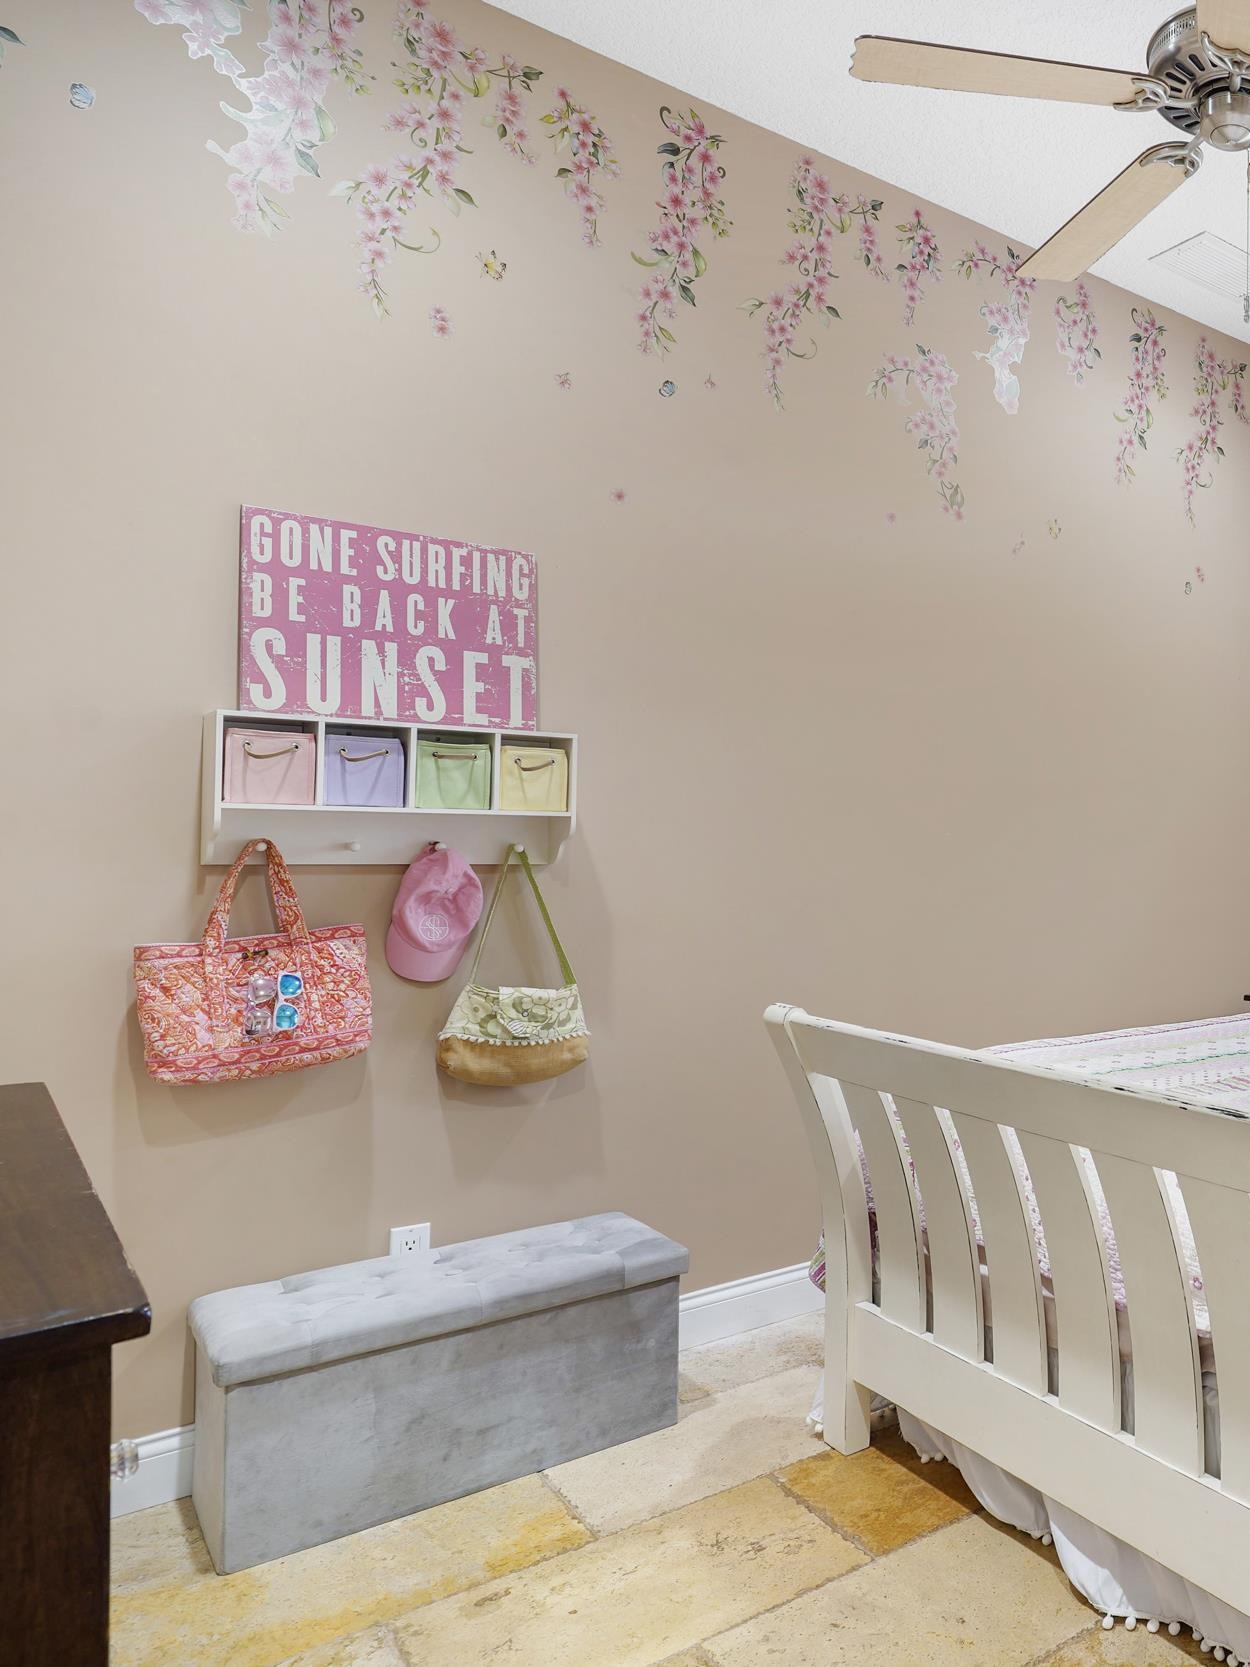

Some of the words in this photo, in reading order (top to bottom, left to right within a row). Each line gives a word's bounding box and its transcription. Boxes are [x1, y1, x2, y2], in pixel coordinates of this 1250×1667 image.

[250, 514, 358, 577] GONE
[376, 535, 530, 601] SURFING
[251, 572, 307, 623] BE
[342, 583, 457, 640] BACK
[486, 604, 529, 648] AT
[249, 627, 531, 728] SUNSET
